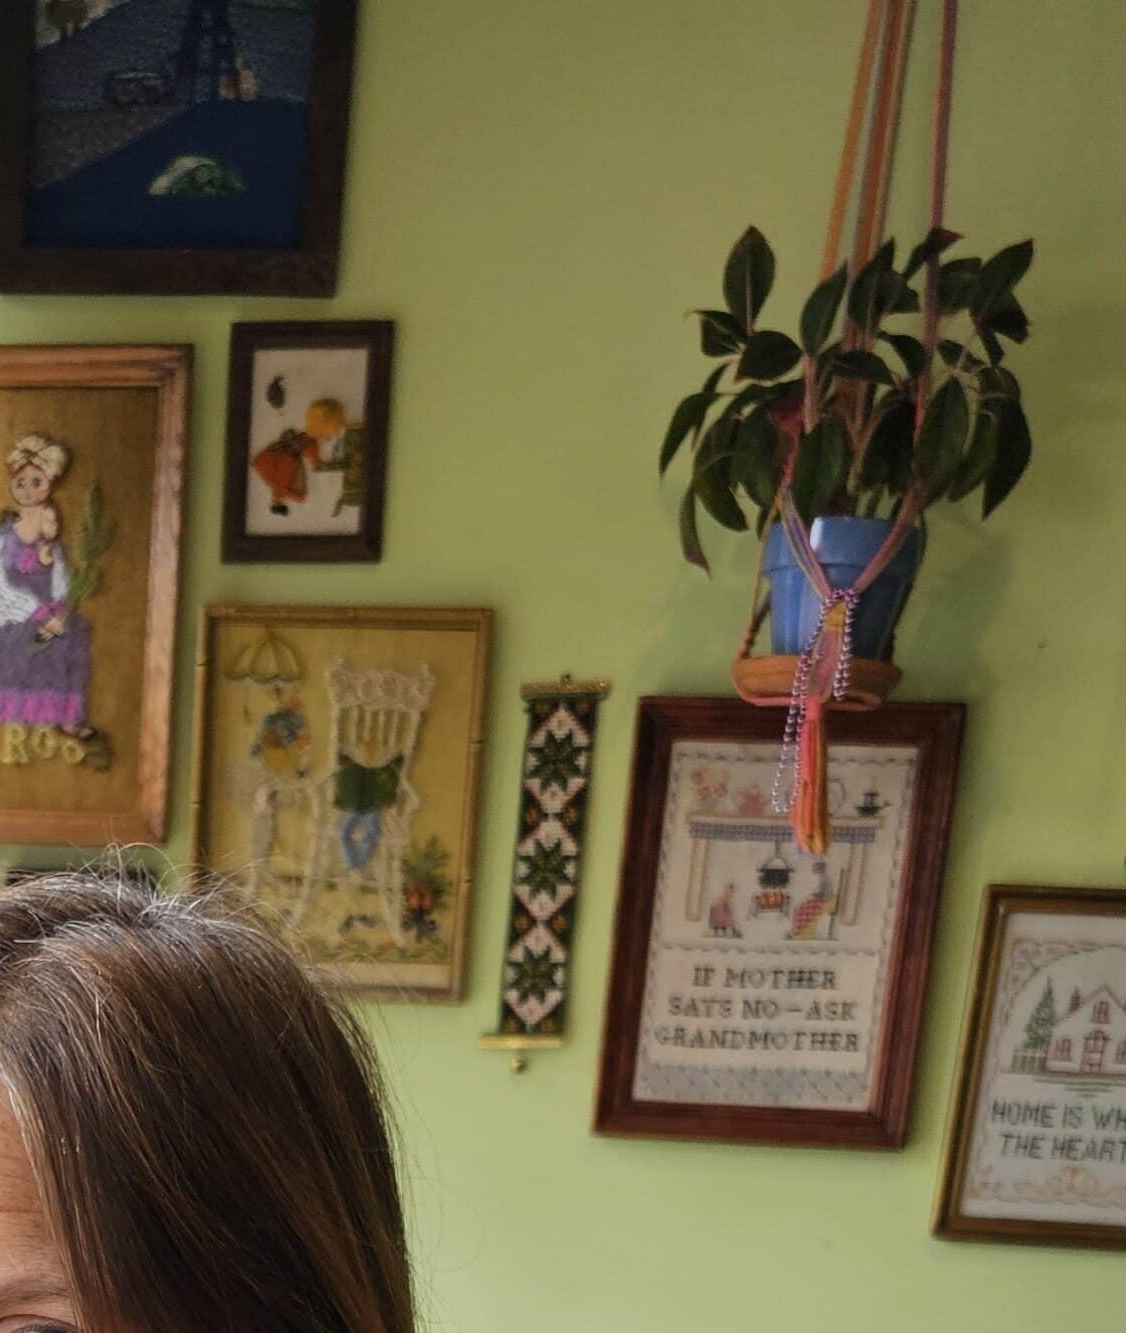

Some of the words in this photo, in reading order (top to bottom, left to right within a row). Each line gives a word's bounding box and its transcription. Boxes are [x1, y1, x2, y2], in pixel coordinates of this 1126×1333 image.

[693, 966, 715, 987] IF
[723, 967, 838, 990] MOTHER
[668, 995, 733, 1019] SAYS
[654, 1025, 859, 1052] GRANDMOTHER
[992, 1100, 1056, 1129] HOME
[1062, 1103, 1083, 1129] IS
[1000, 1132, 1044, 1160] THE
